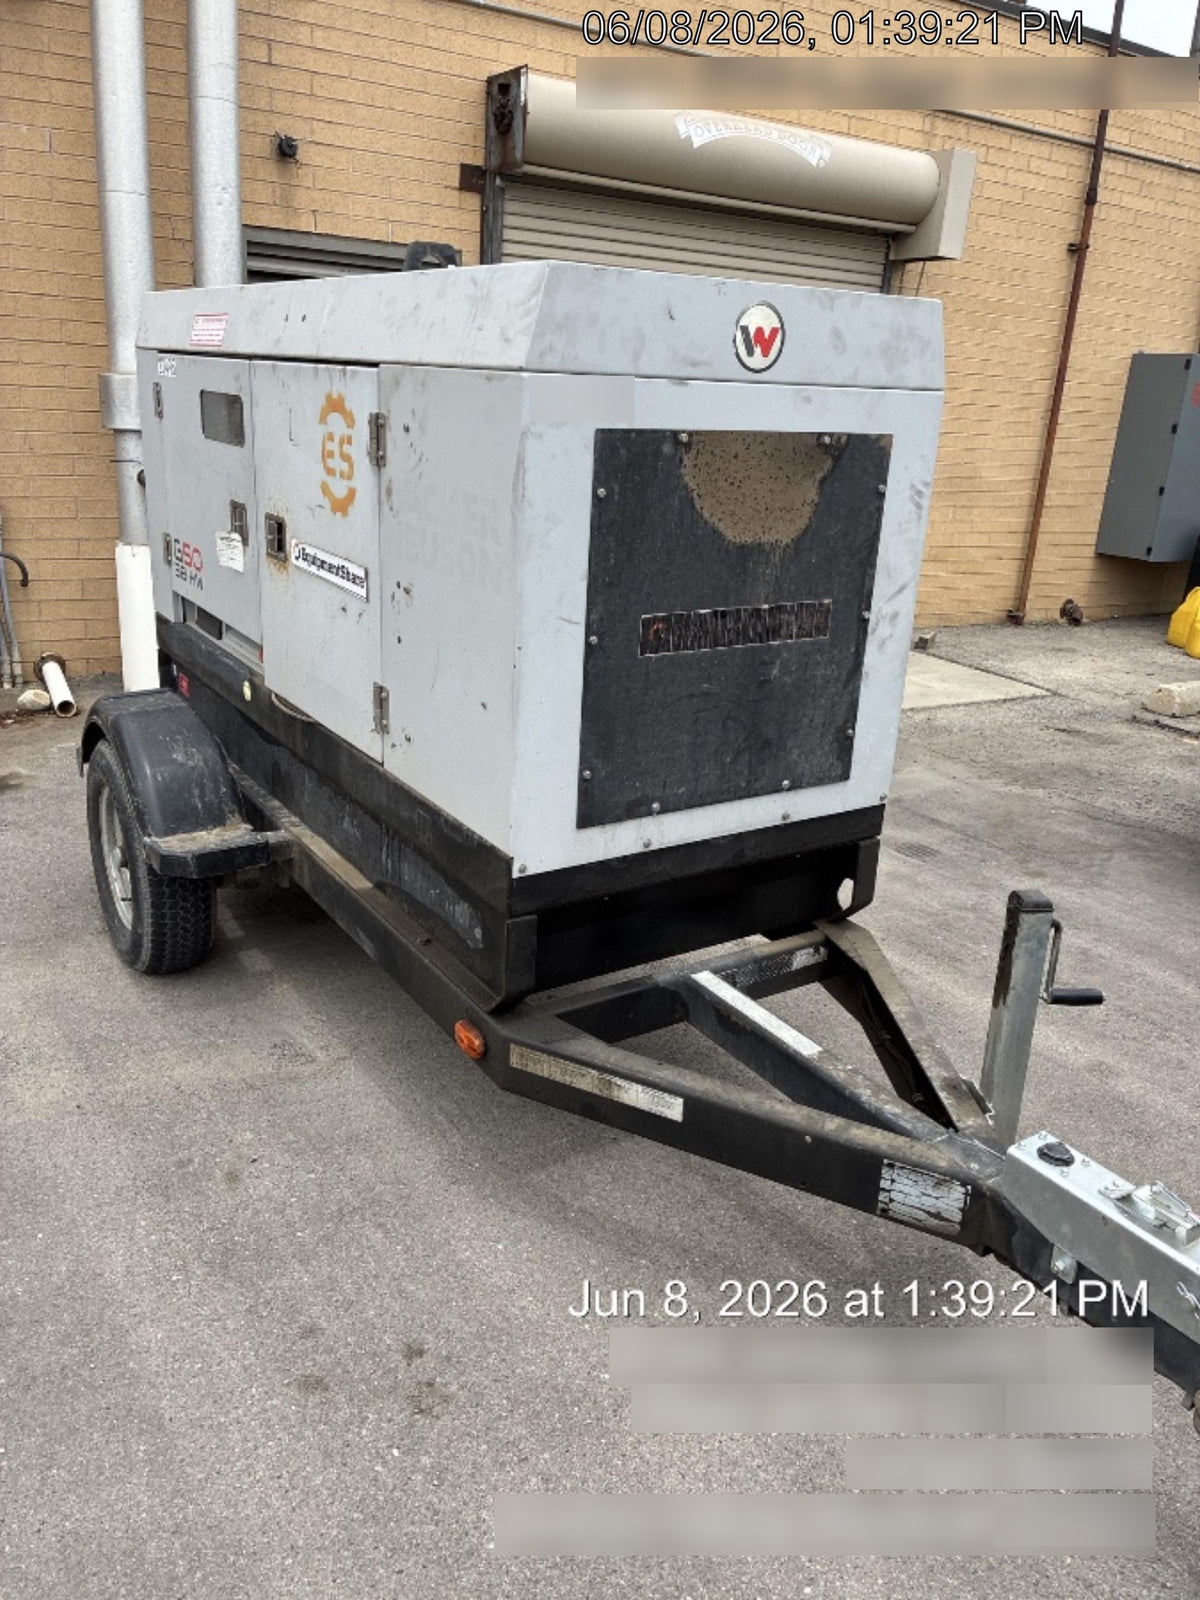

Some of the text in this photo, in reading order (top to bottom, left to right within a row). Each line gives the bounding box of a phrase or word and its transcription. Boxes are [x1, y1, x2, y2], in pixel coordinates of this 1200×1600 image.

[321, 431, 355, 481] ES
[173, 538, 204, 574] G50
[301, 547, 364, 589] EquipmentShare
